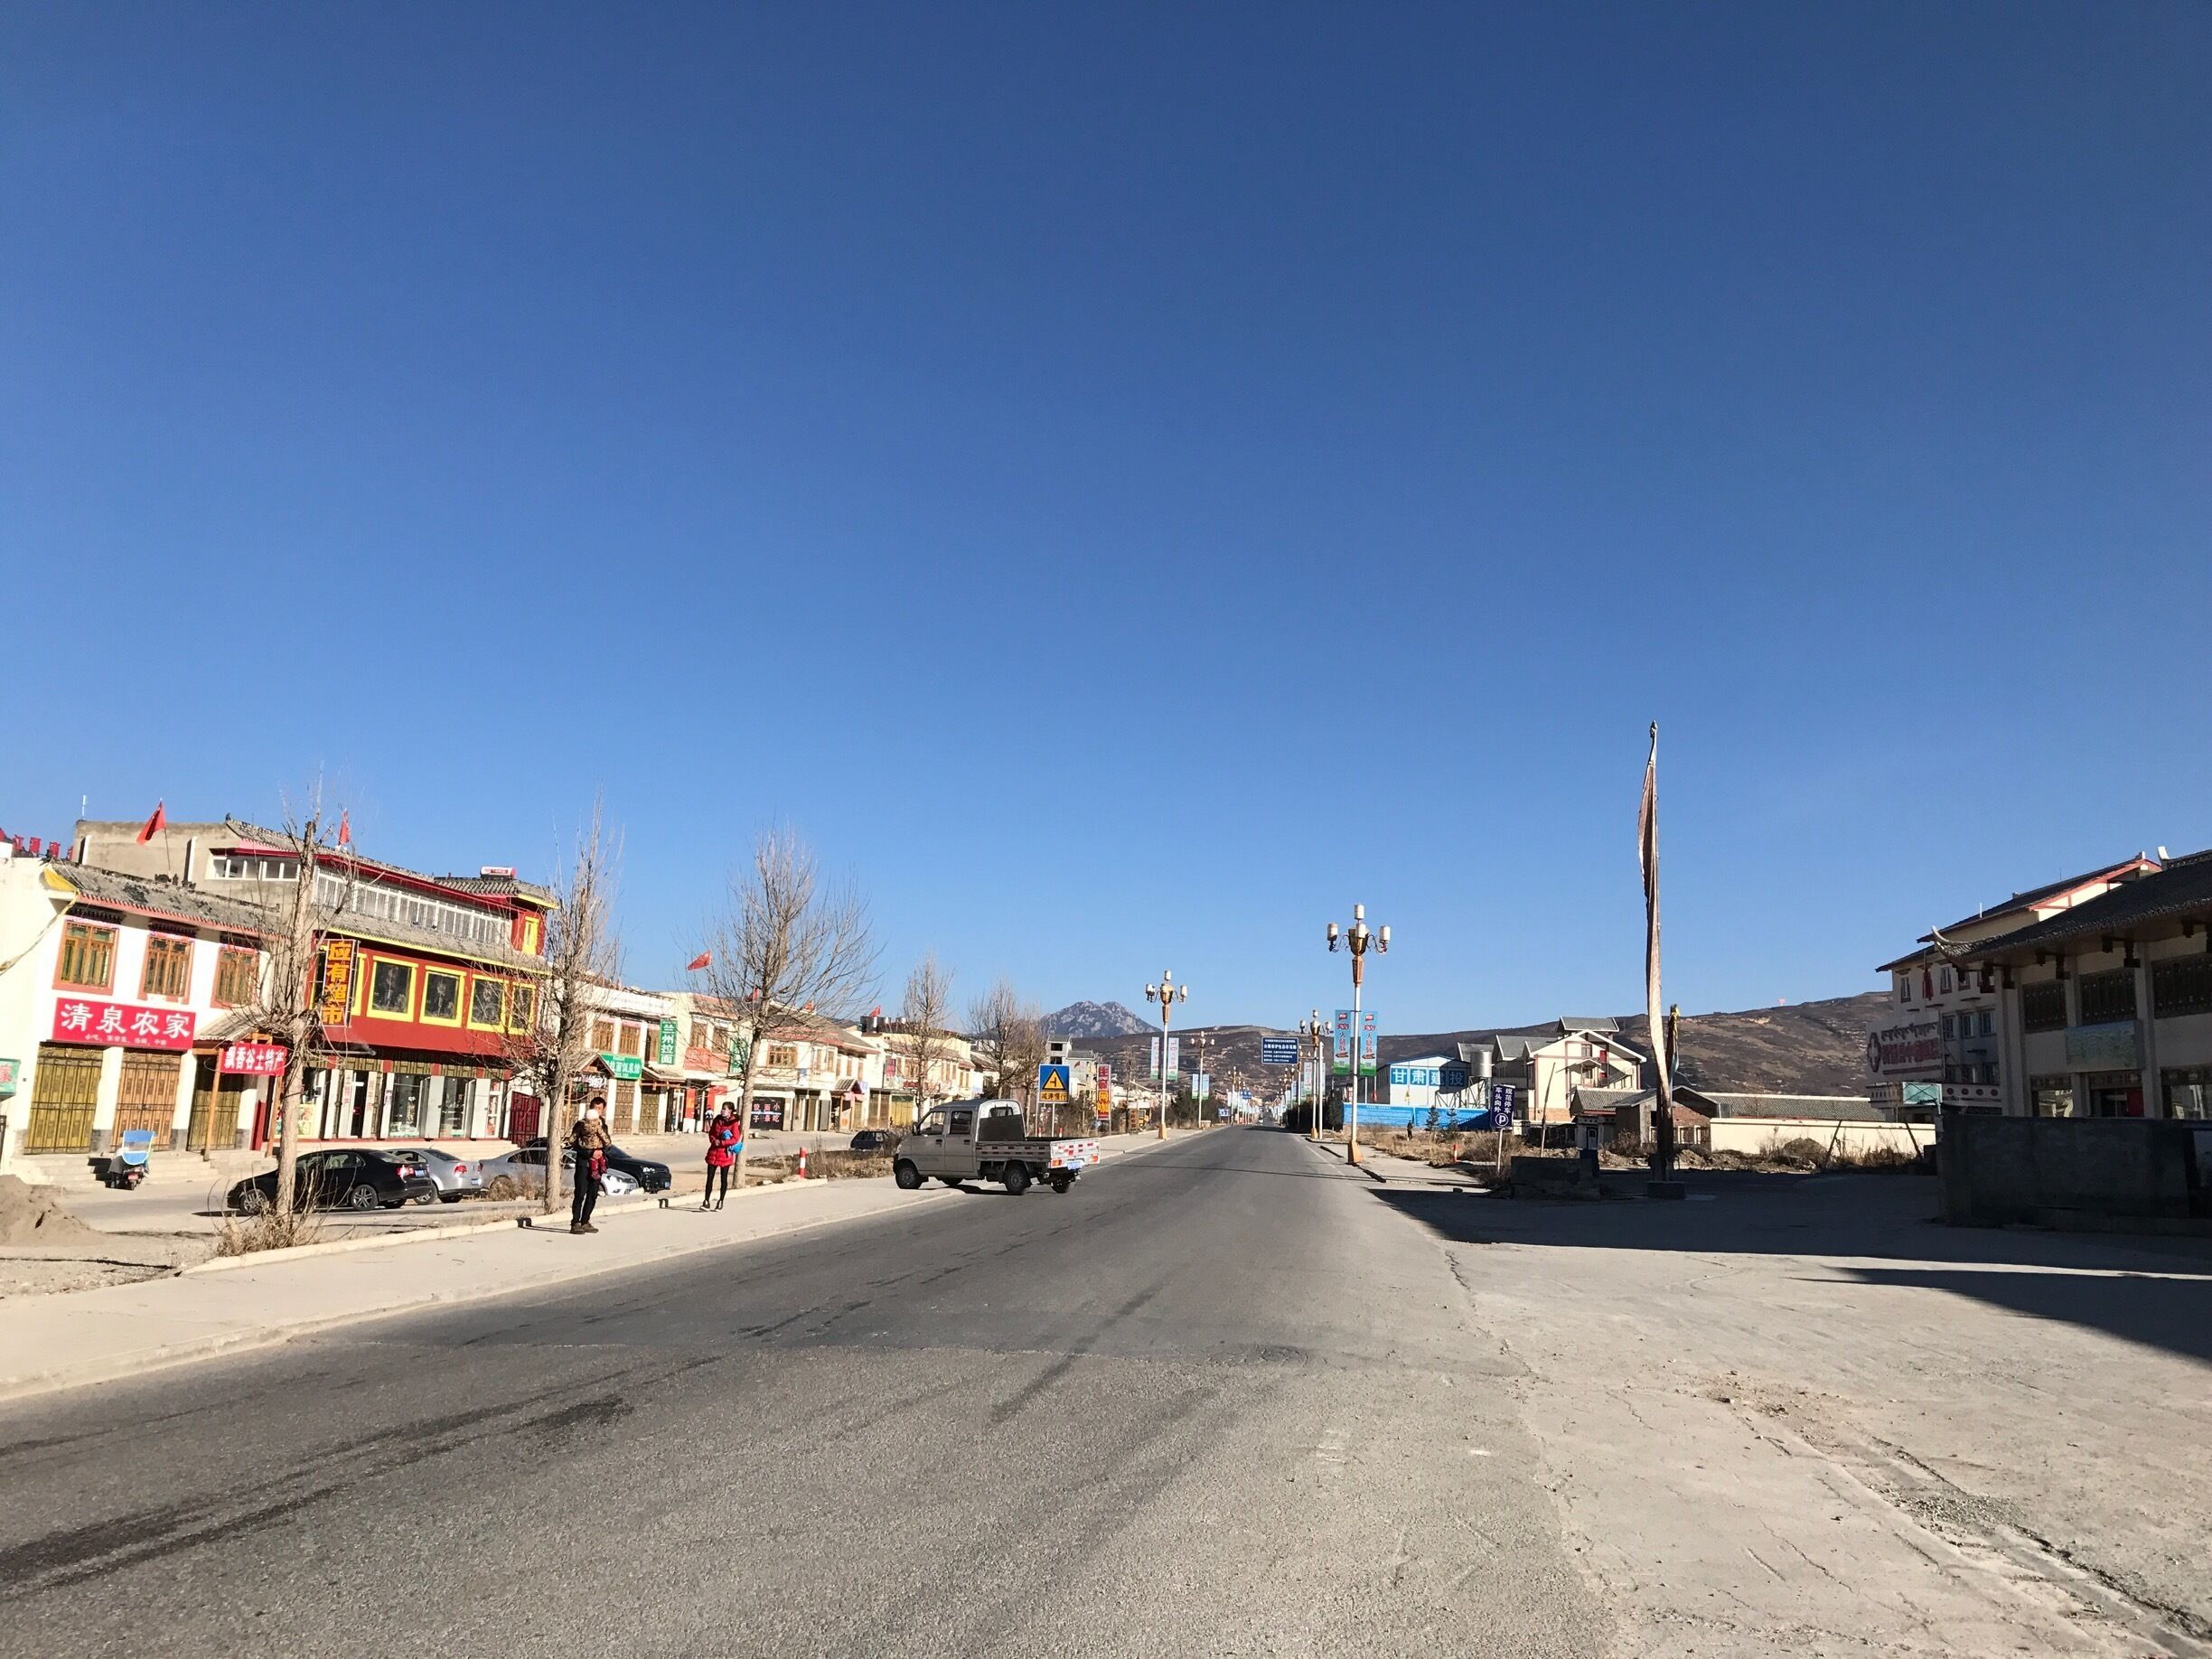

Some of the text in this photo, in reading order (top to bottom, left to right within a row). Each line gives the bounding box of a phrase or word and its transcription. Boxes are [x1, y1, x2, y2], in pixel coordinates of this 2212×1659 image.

[321, 942, 352, 1025] 应有超市
[60, 1002, 191, 1039] 清泉农家
[661, 1024, 676, 1064] 兰州拉面
[1392, 1068, 1465, 1086] 甘肃建投
[1494, 1087, 1503, 1112] 车头向外
